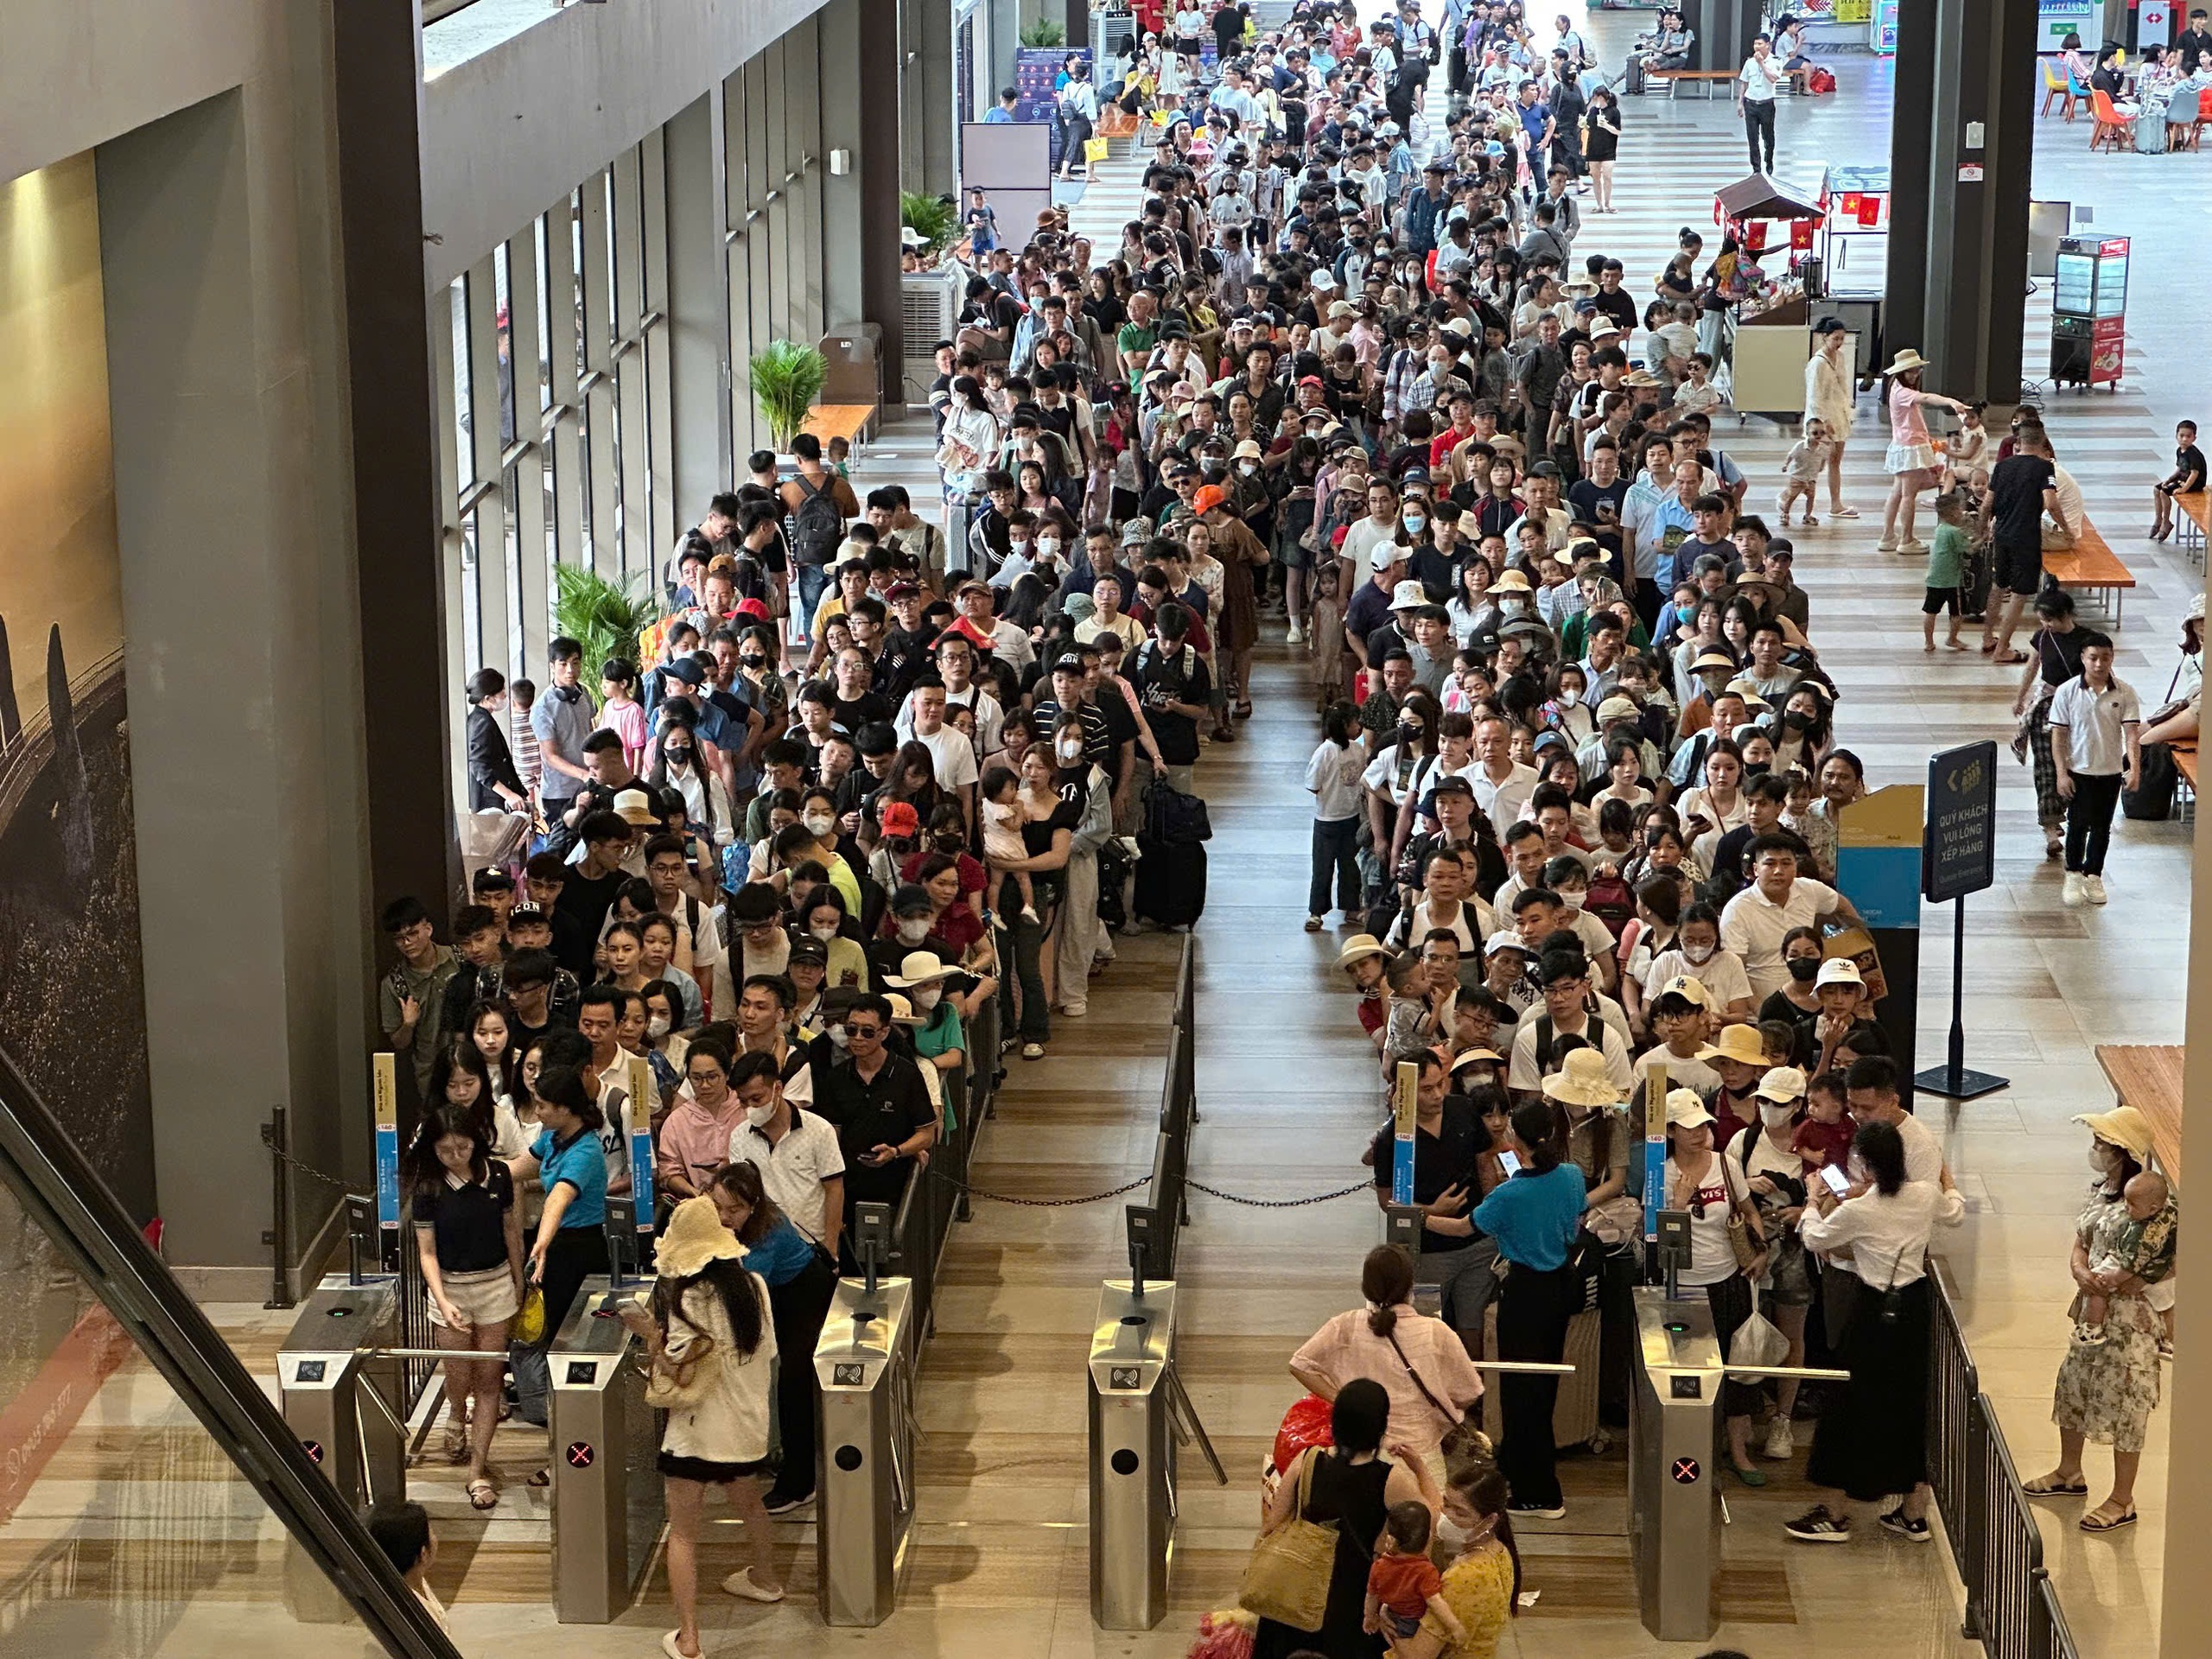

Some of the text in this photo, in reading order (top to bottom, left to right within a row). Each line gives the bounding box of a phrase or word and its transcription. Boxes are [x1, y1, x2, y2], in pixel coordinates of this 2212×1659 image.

[1939, 804, 1988, 828] QUÝ KHÁCH
[1943, 830, 1958, 845] VUI
[1941, 840, 1984, 863] XẾP HÀNG
[510, 902, 540, 917] ICON
